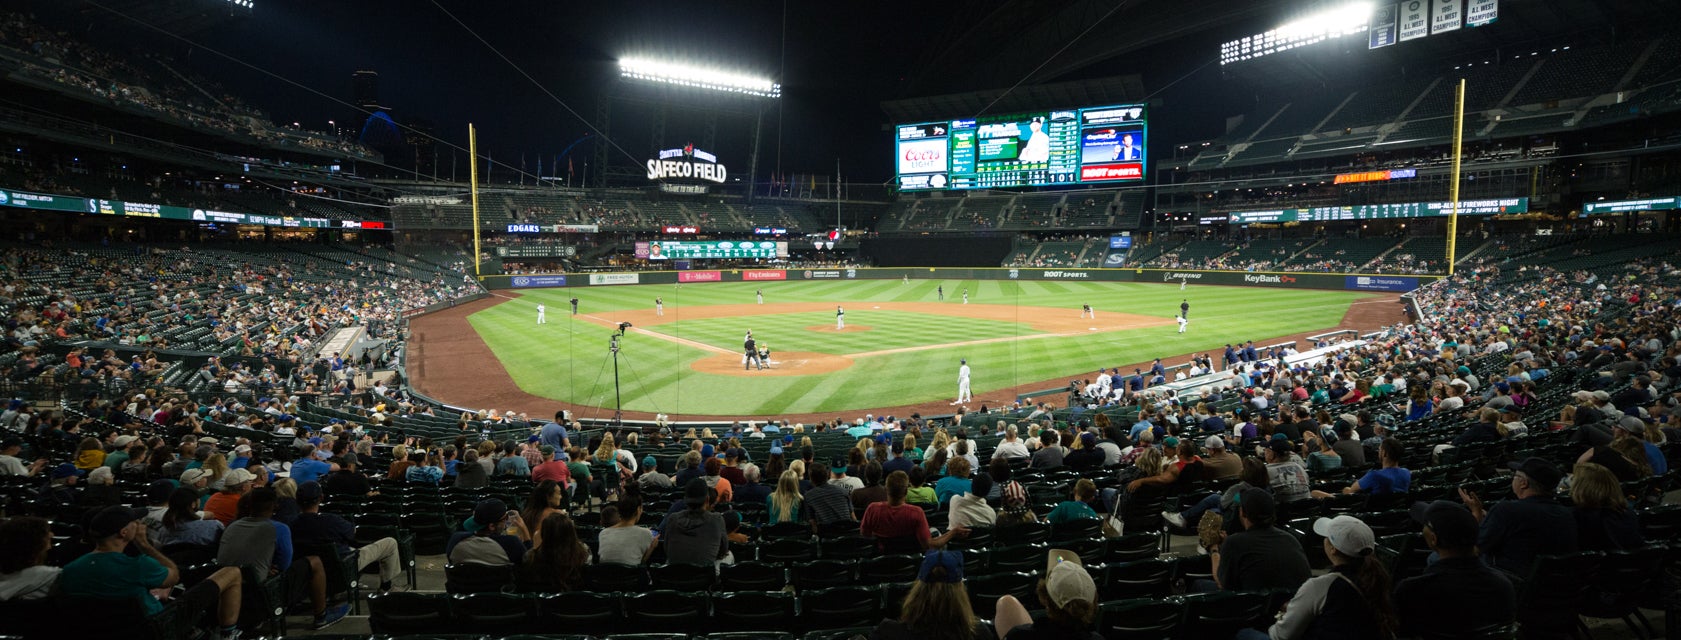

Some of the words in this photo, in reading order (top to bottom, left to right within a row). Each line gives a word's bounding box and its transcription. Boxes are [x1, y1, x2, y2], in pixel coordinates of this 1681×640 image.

[1480, 3, 1494, 11] WEST
[1444, 12, 1458, 20] WEST
[1468, 11, 1497, 23] CHAMPIONS
[1411, 20, 1425, 28] WEST
[1433, 19, 1460, 32] CHAMPIONS
[1401, 28, 1426, 38] CHAMPIONS
[905, 148, 940, 161] Coors
[647, 159, 692, 179] SAFECO
[694, 162, 726, 183] FIELD
[1050, 174, 1055, 182] 1
[1059, 174, 1065, 182] 0
[1069, 173, 1074, 181] 1
[1463, 200, 1498, 208] FIREWORKS
[1245, 274, 1280, 283] KeyBank
